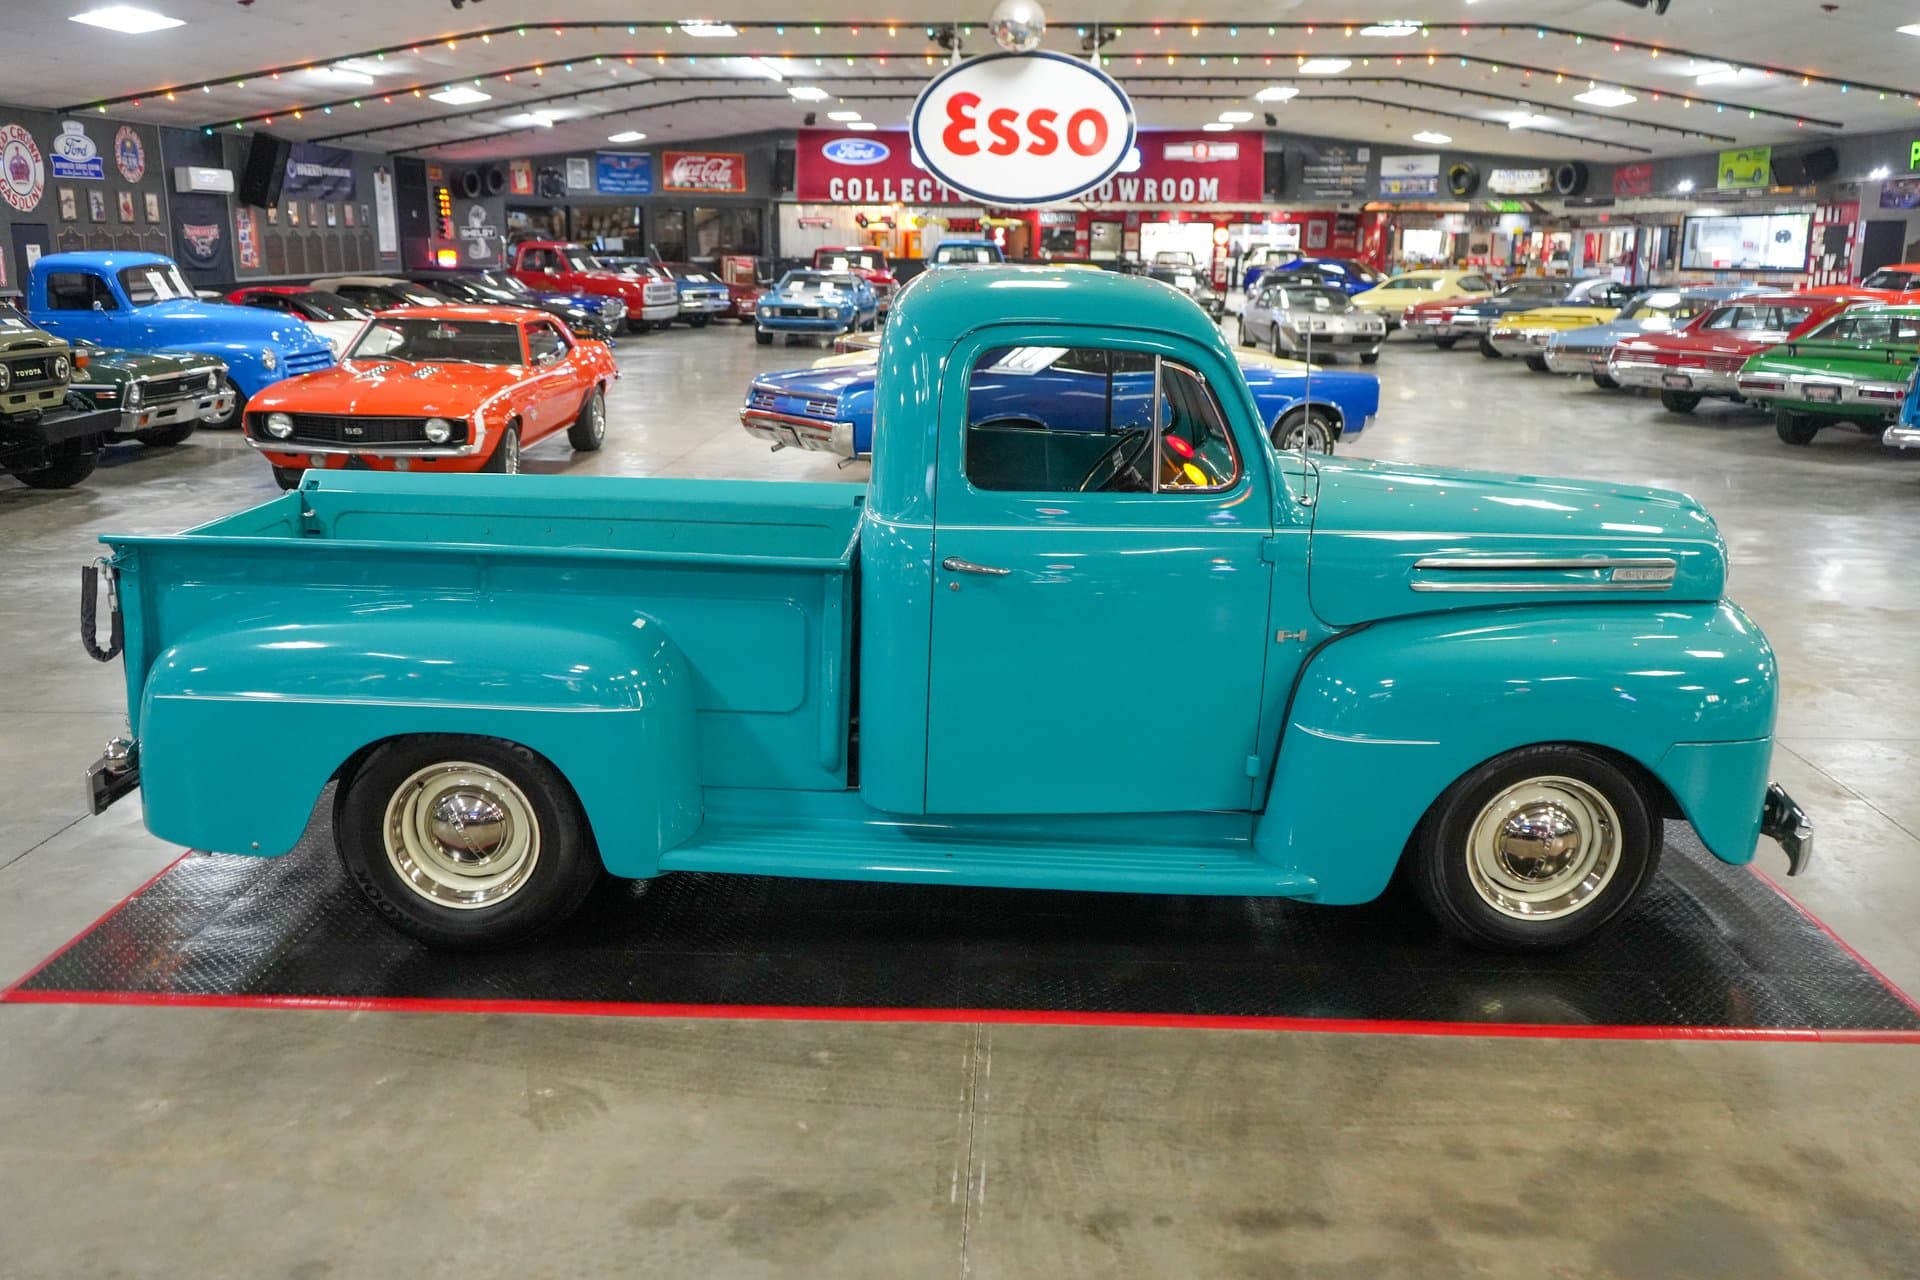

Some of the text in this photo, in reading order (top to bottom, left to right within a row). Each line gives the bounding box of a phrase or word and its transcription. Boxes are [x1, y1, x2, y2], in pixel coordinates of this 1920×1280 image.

[941, 91, 1110, 157] Esso
[9, 126, 41, 165] CROWN
[64, 137, 88, 157] Ford
[836, 142, 876, 160] Ford
[0, 178, 43, 210] GASOLINE
[829, 176, 1219, 203] COLLECT OWROOM
[15, 367, 42, 378] TOYOTA
[344, 426, 364, 436] SS
